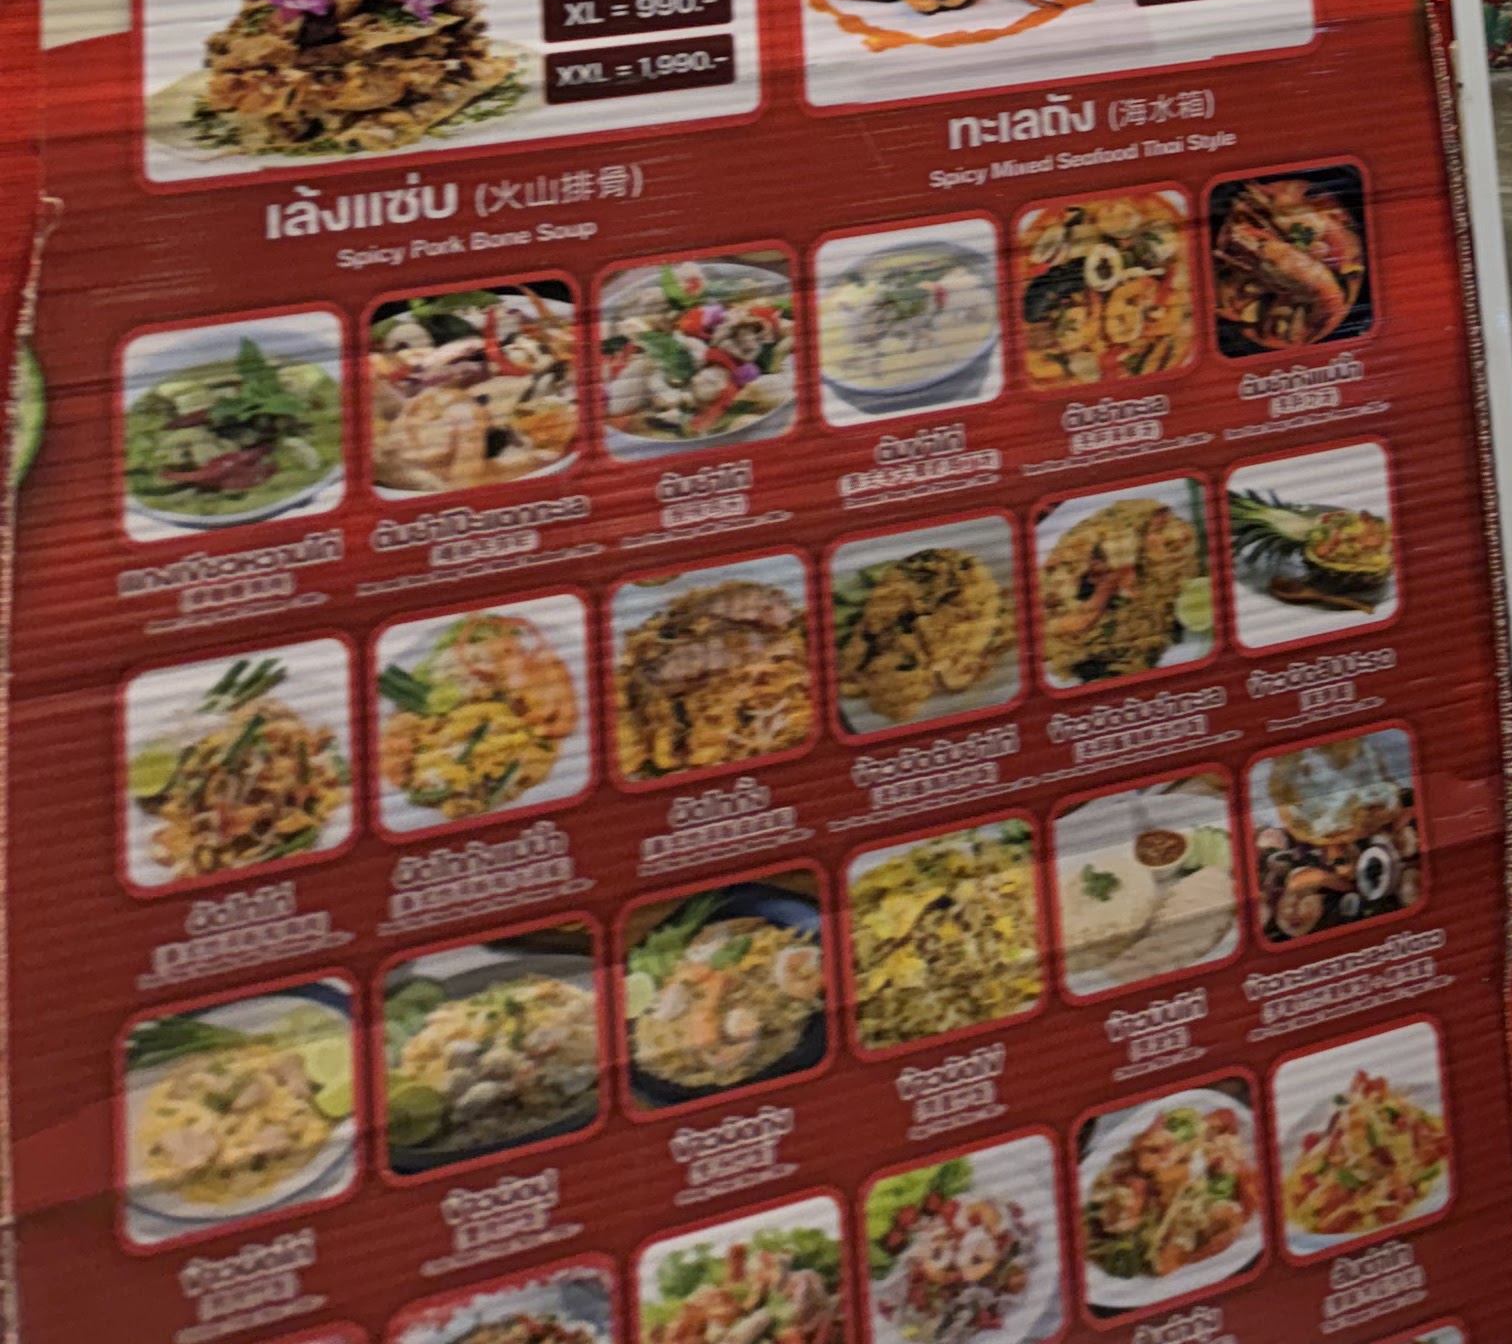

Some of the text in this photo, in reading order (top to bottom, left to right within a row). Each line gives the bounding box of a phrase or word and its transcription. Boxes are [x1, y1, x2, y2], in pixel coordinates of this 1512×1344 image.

[563, 1, 606, 26] XL
[556, 62, 611, 87] XXL
[948, 93, 1096, 150] ทะเลถัง
[929, 166, 988, 189] Spicy
[990, 155, 1054, 179] Mixed
[1056, 142, 1139, 169] Seafood
[1186, 131, 1237, 153] Style
[266, 171, 459, 240] เล้งแซ่บ
[337, 221, 597, 269] Spicy Pork Bone Soup
